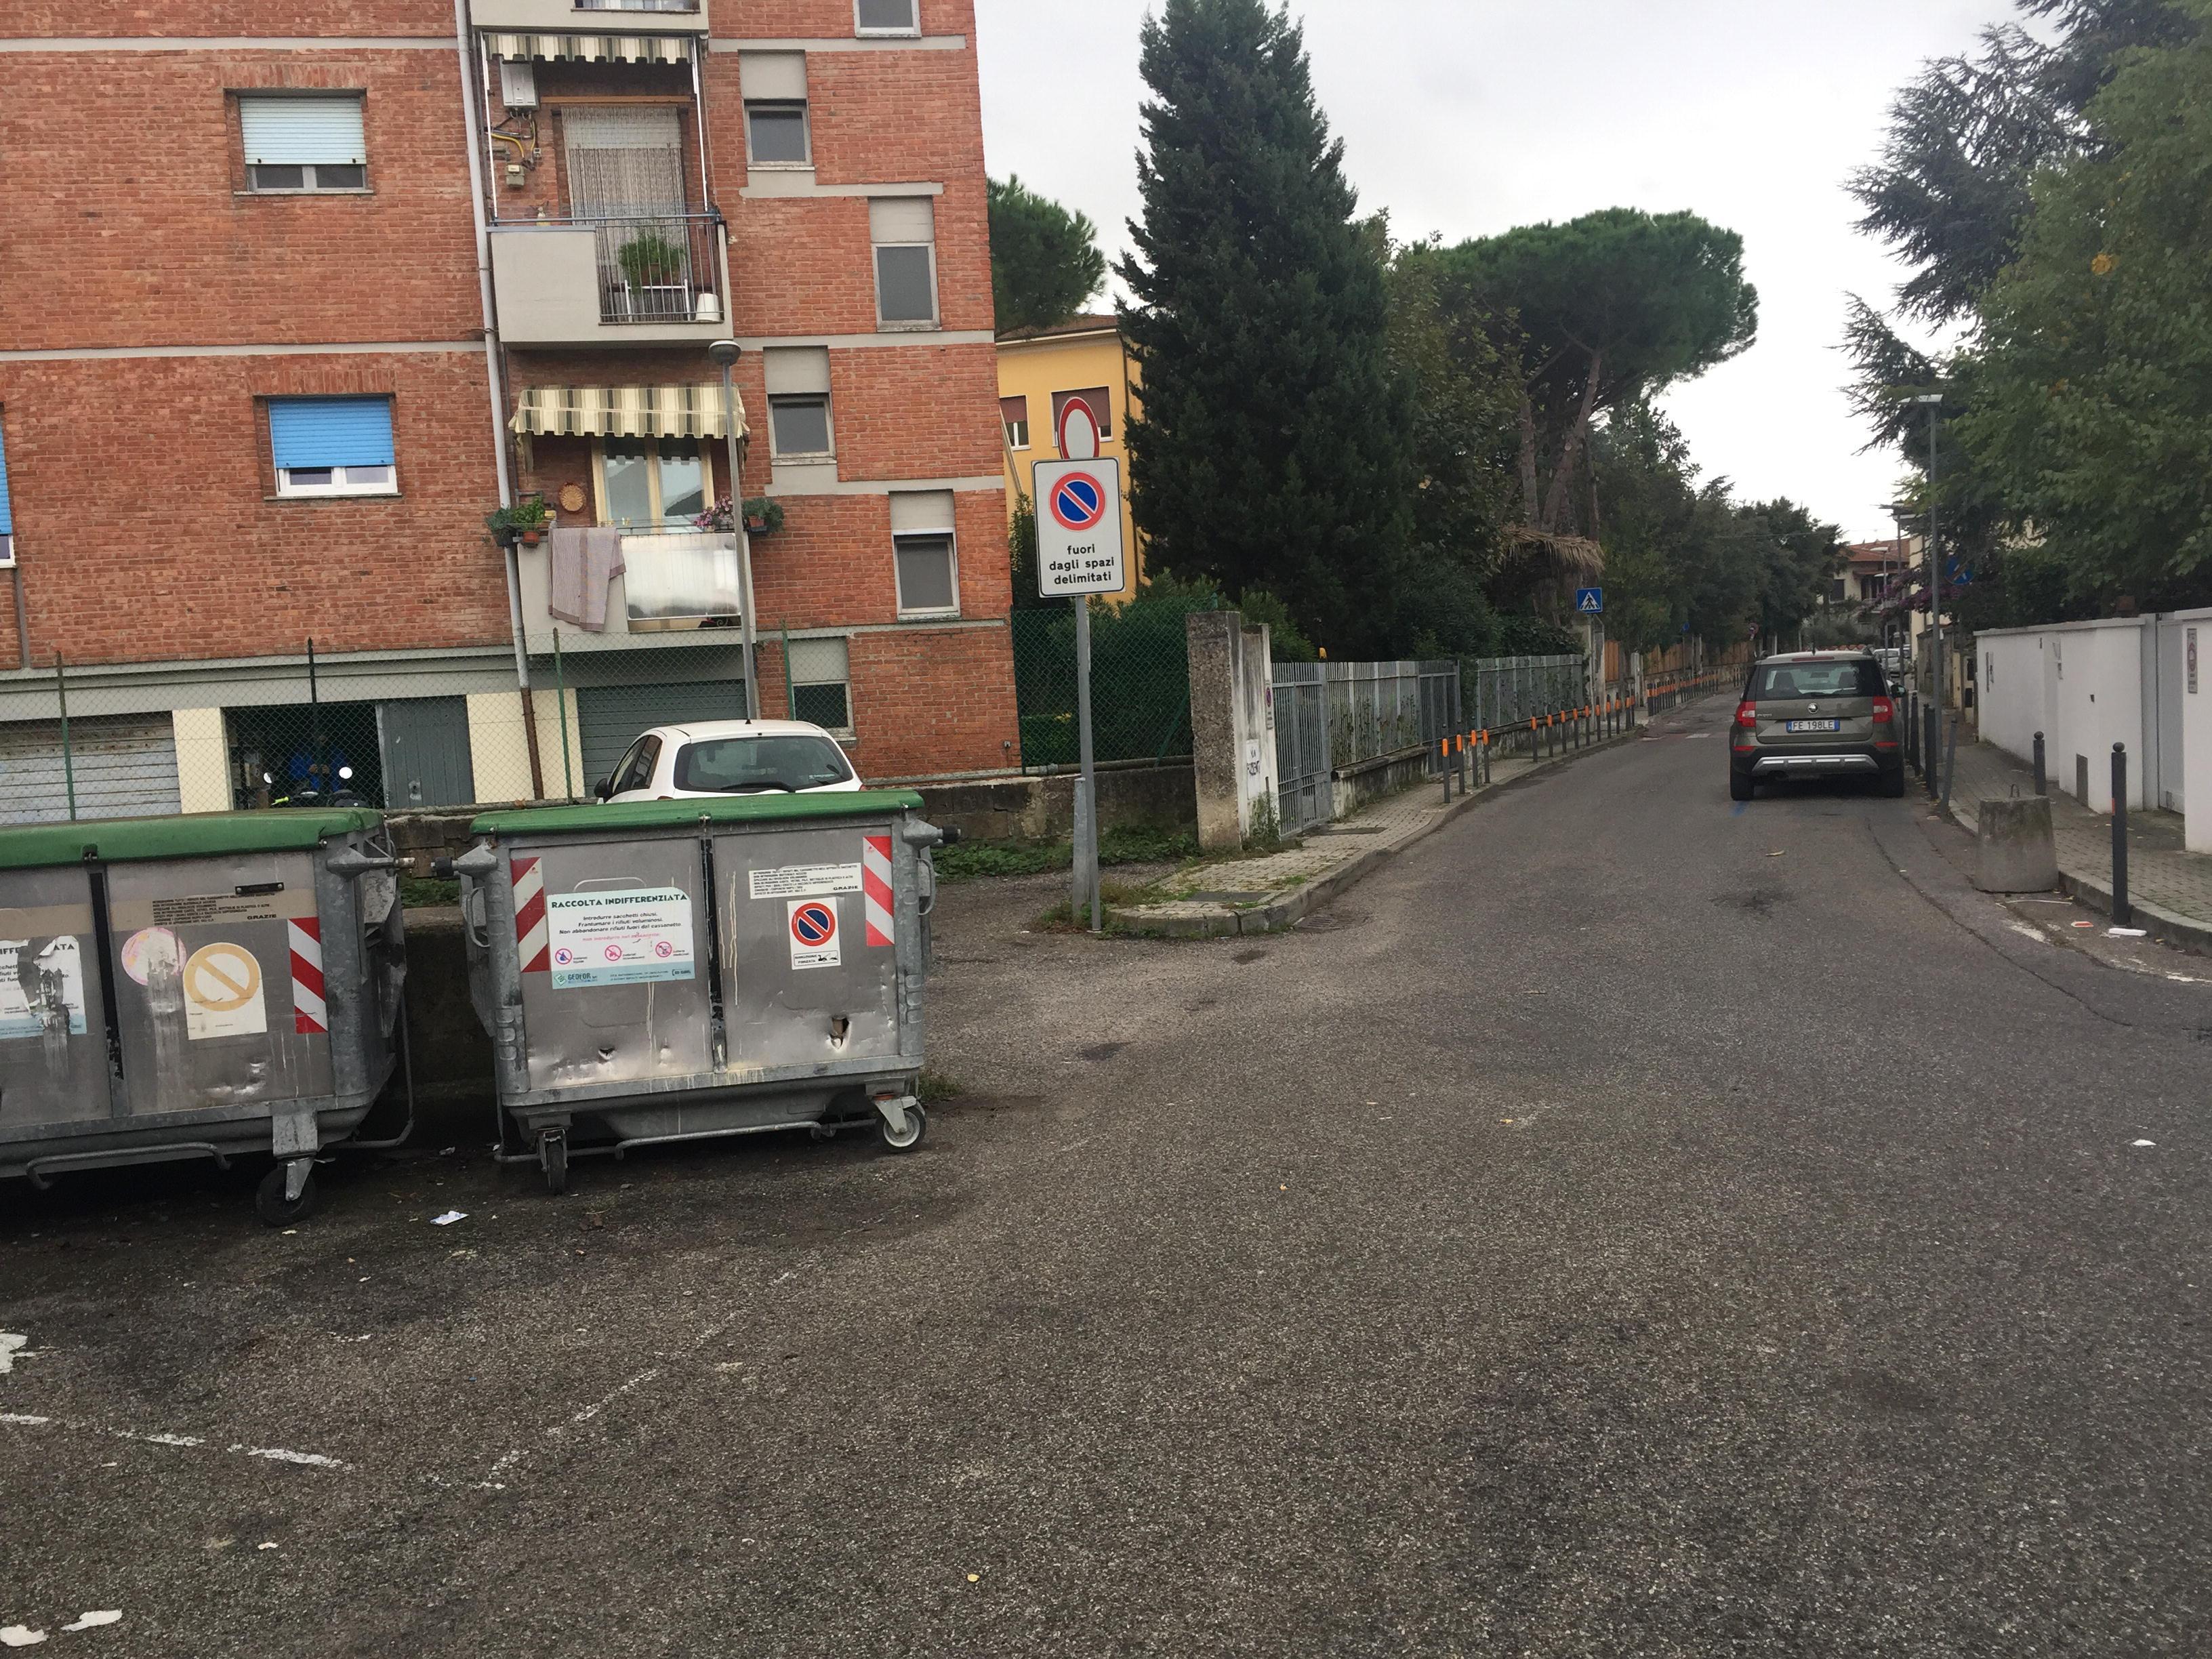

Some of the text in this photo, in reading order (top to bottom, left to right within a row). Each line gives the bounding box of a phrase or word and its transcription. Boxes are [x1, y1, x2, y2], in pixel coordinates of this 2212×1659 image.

[1067, 544, 1095, 555] fuori
[1049, 556, 1115, 571] dagli spazi
[1054, 571, 1111, 585] delimitati
[1793, 720, 1834, 730] FE 198LE
[552, 894, 687, 909] RACCOLTA INDIFFERENZIATA
